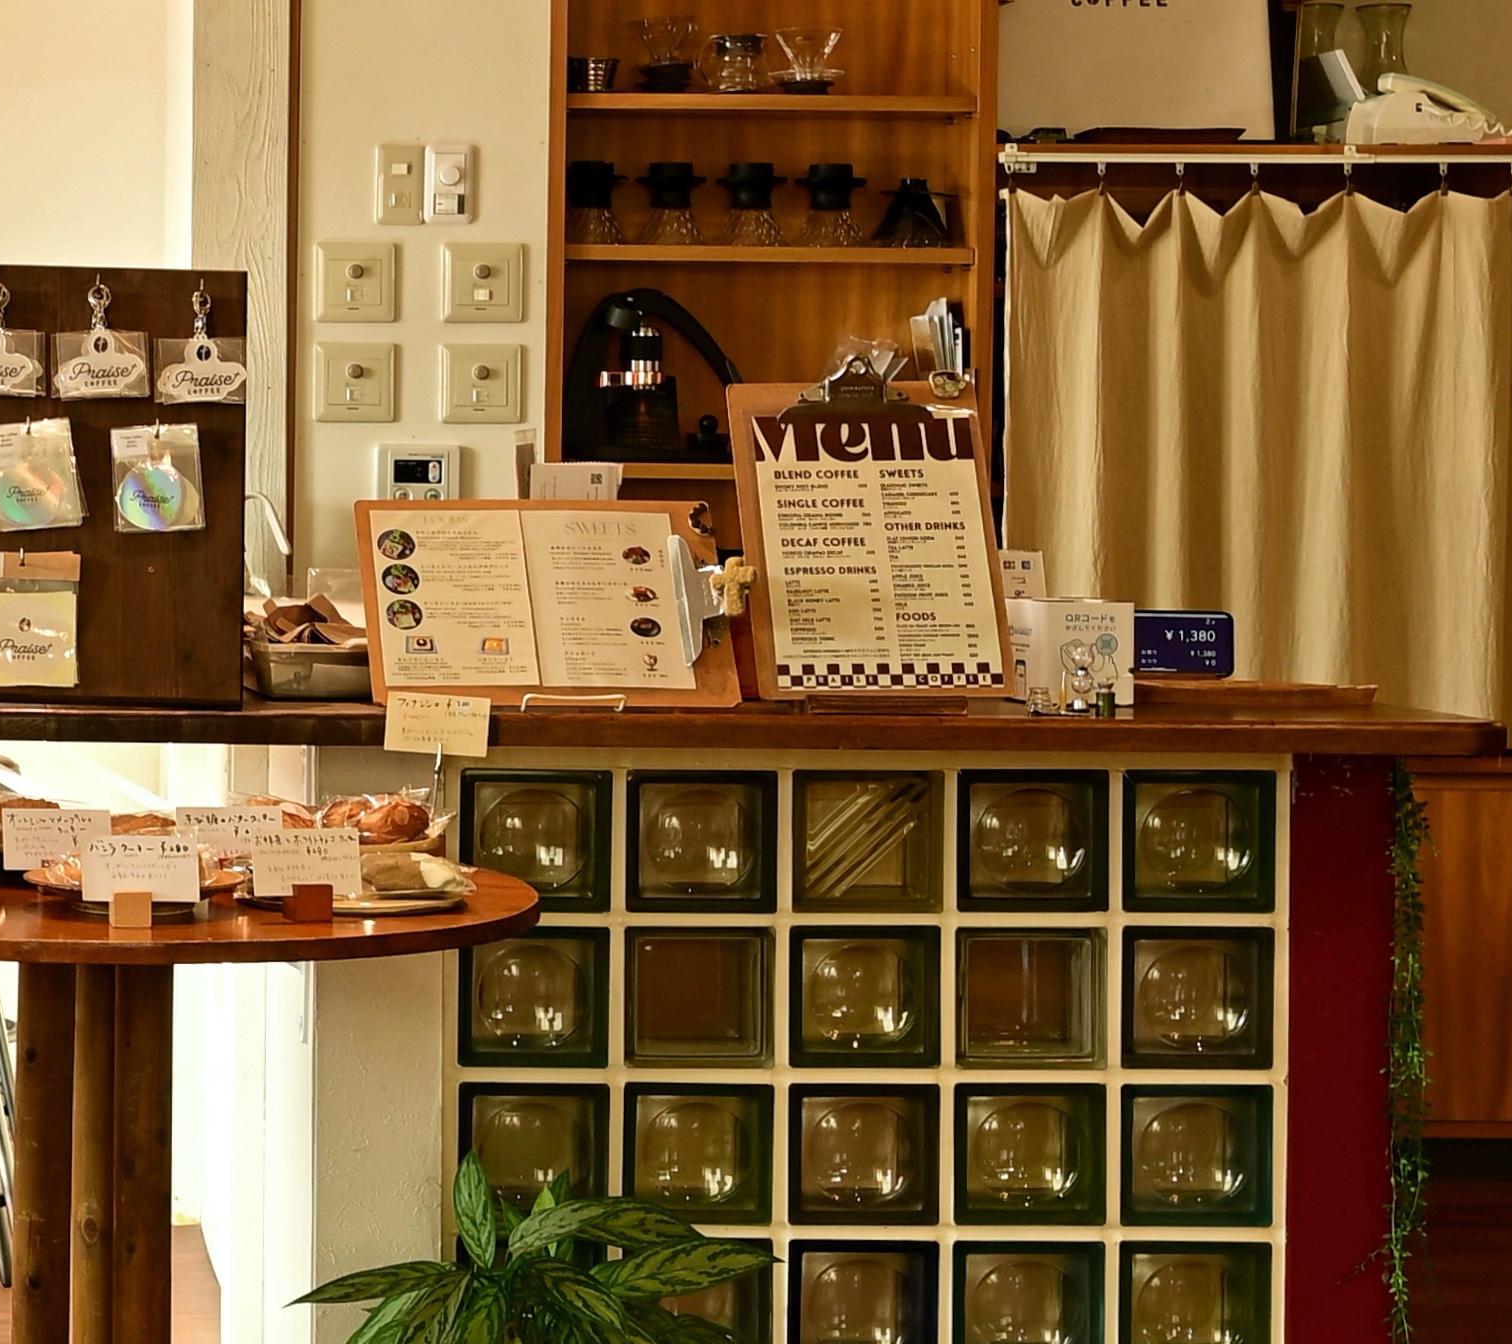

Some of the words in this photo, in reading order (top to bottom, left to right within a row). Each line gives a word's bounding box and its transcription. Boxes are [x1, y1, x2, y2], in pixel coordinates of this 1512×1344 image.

[84, 378, 118, 388] COFFEE
[187, 387, 222, 397] COFFEE
[774, 470, 812, 480] BLEND
[816, 469, 860, 479] COFFEE
[879, 469, 924, 479] SWEETS
[777, 499, 818, 508] SINGLE
[821, 498, 865, 508] COFFEE
[564, 521, 638, 535] SWEETS
[884, 522, 922, 531] OTHER
[925, 522, 966, 531] DRINKS
[781, 538, 818, 548] DECAF
[822, 537, 866, 547] COFFEE
[784, 566, 836, 575] ESPRESSO
[838, 566, 877, 575] DRINKS
[896, 612, 937, 621] FOODS
[1065, 613, 1116, 624] QRコードを
